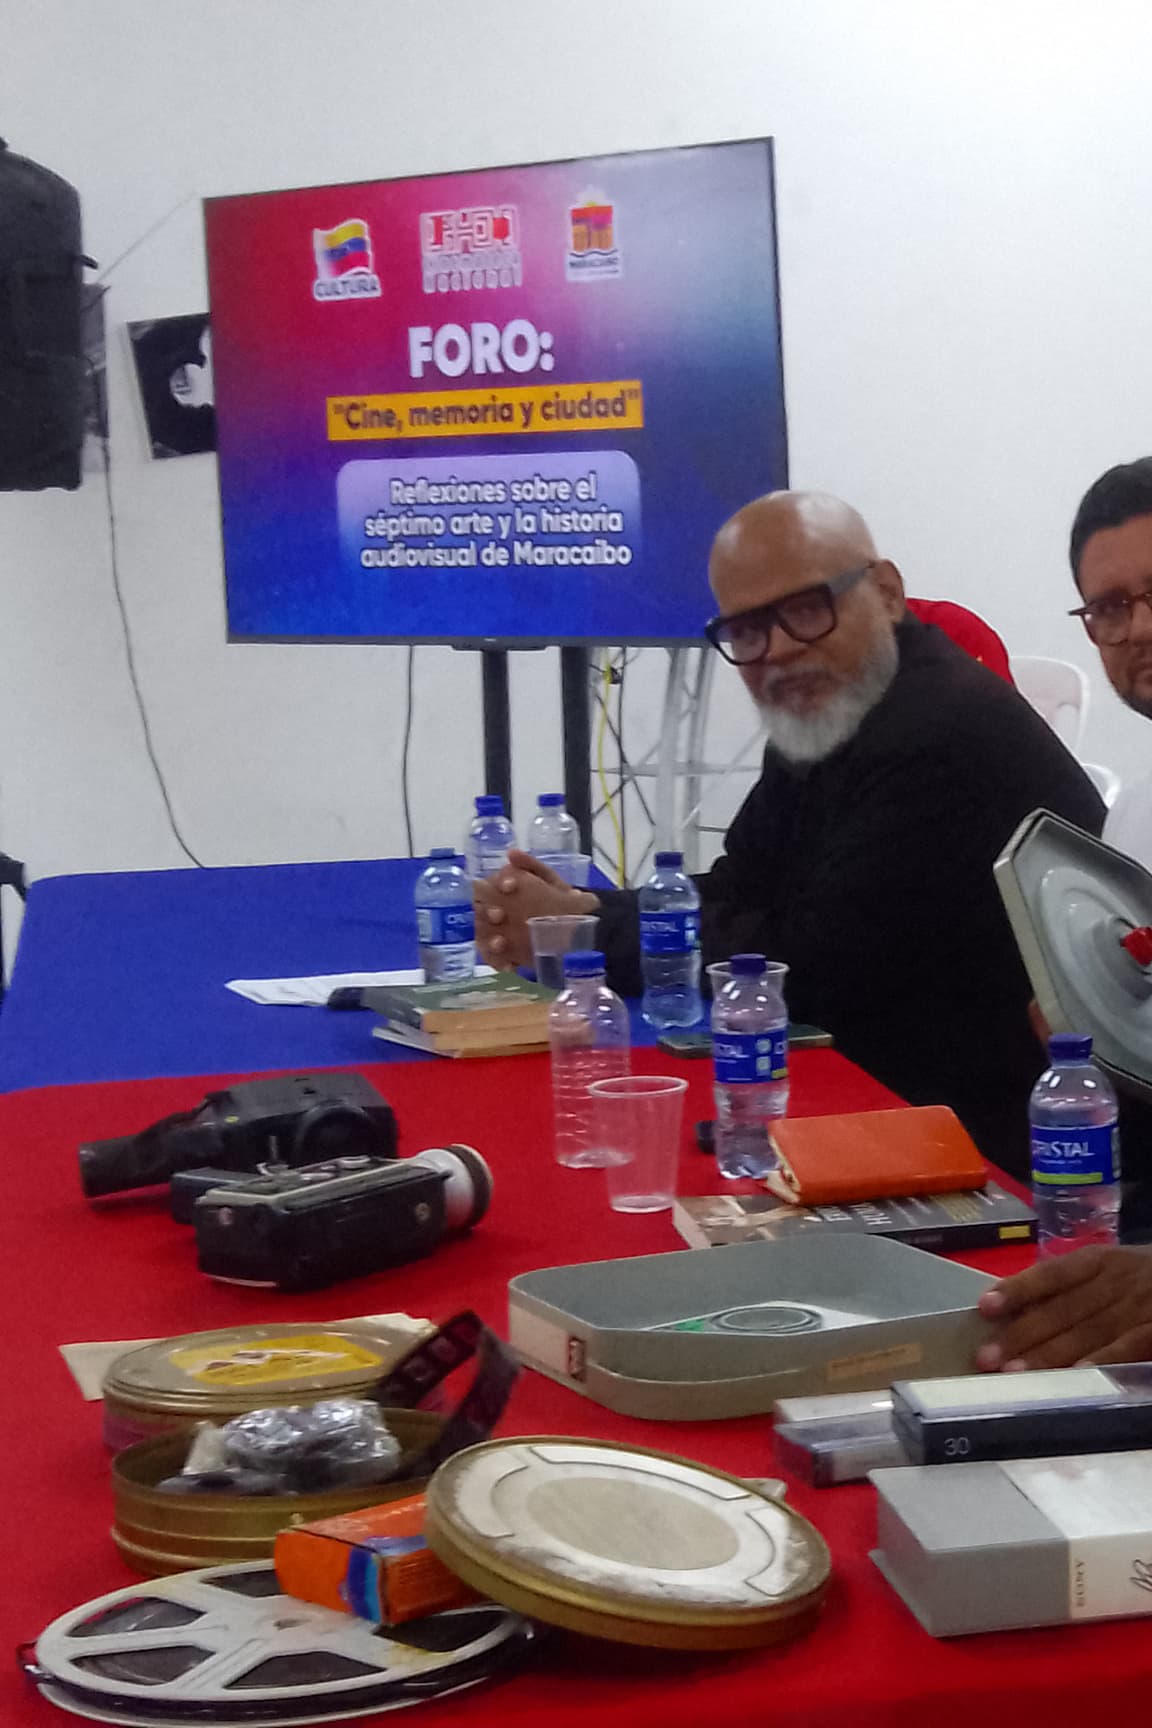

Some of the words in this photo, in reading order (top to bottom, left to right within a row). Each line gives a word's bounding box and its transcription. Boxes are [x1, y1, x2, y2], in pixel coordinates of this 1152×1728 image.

[315, 281, 379, 299] CULTURA
[408, 319, 555, 378] FORO:
[333, 402, 403, 432] "Cine,
[409, 395, 513, 427] memoria
[521, 400, 535, 429] y
[541, 388, 640, 421] ciudad"
[389, 476, 507, 505] Reflexiones
[511, 473, 571, 502] sobre
[575, 470, 597, 500] el
[365, 510, 445, 541] séptimo
[451, 511, 494, 535] arte
[498, 513, 512, 540] y
[515, 505, 537, 533] la
[541, 505, 624, 533] historia
[361, 542, 477, 567] audiovisual
[481, 541, 509, 566] de
[514, 538, 633, 566] Maracaibo
[943, 1436, 972, 1456] 30
